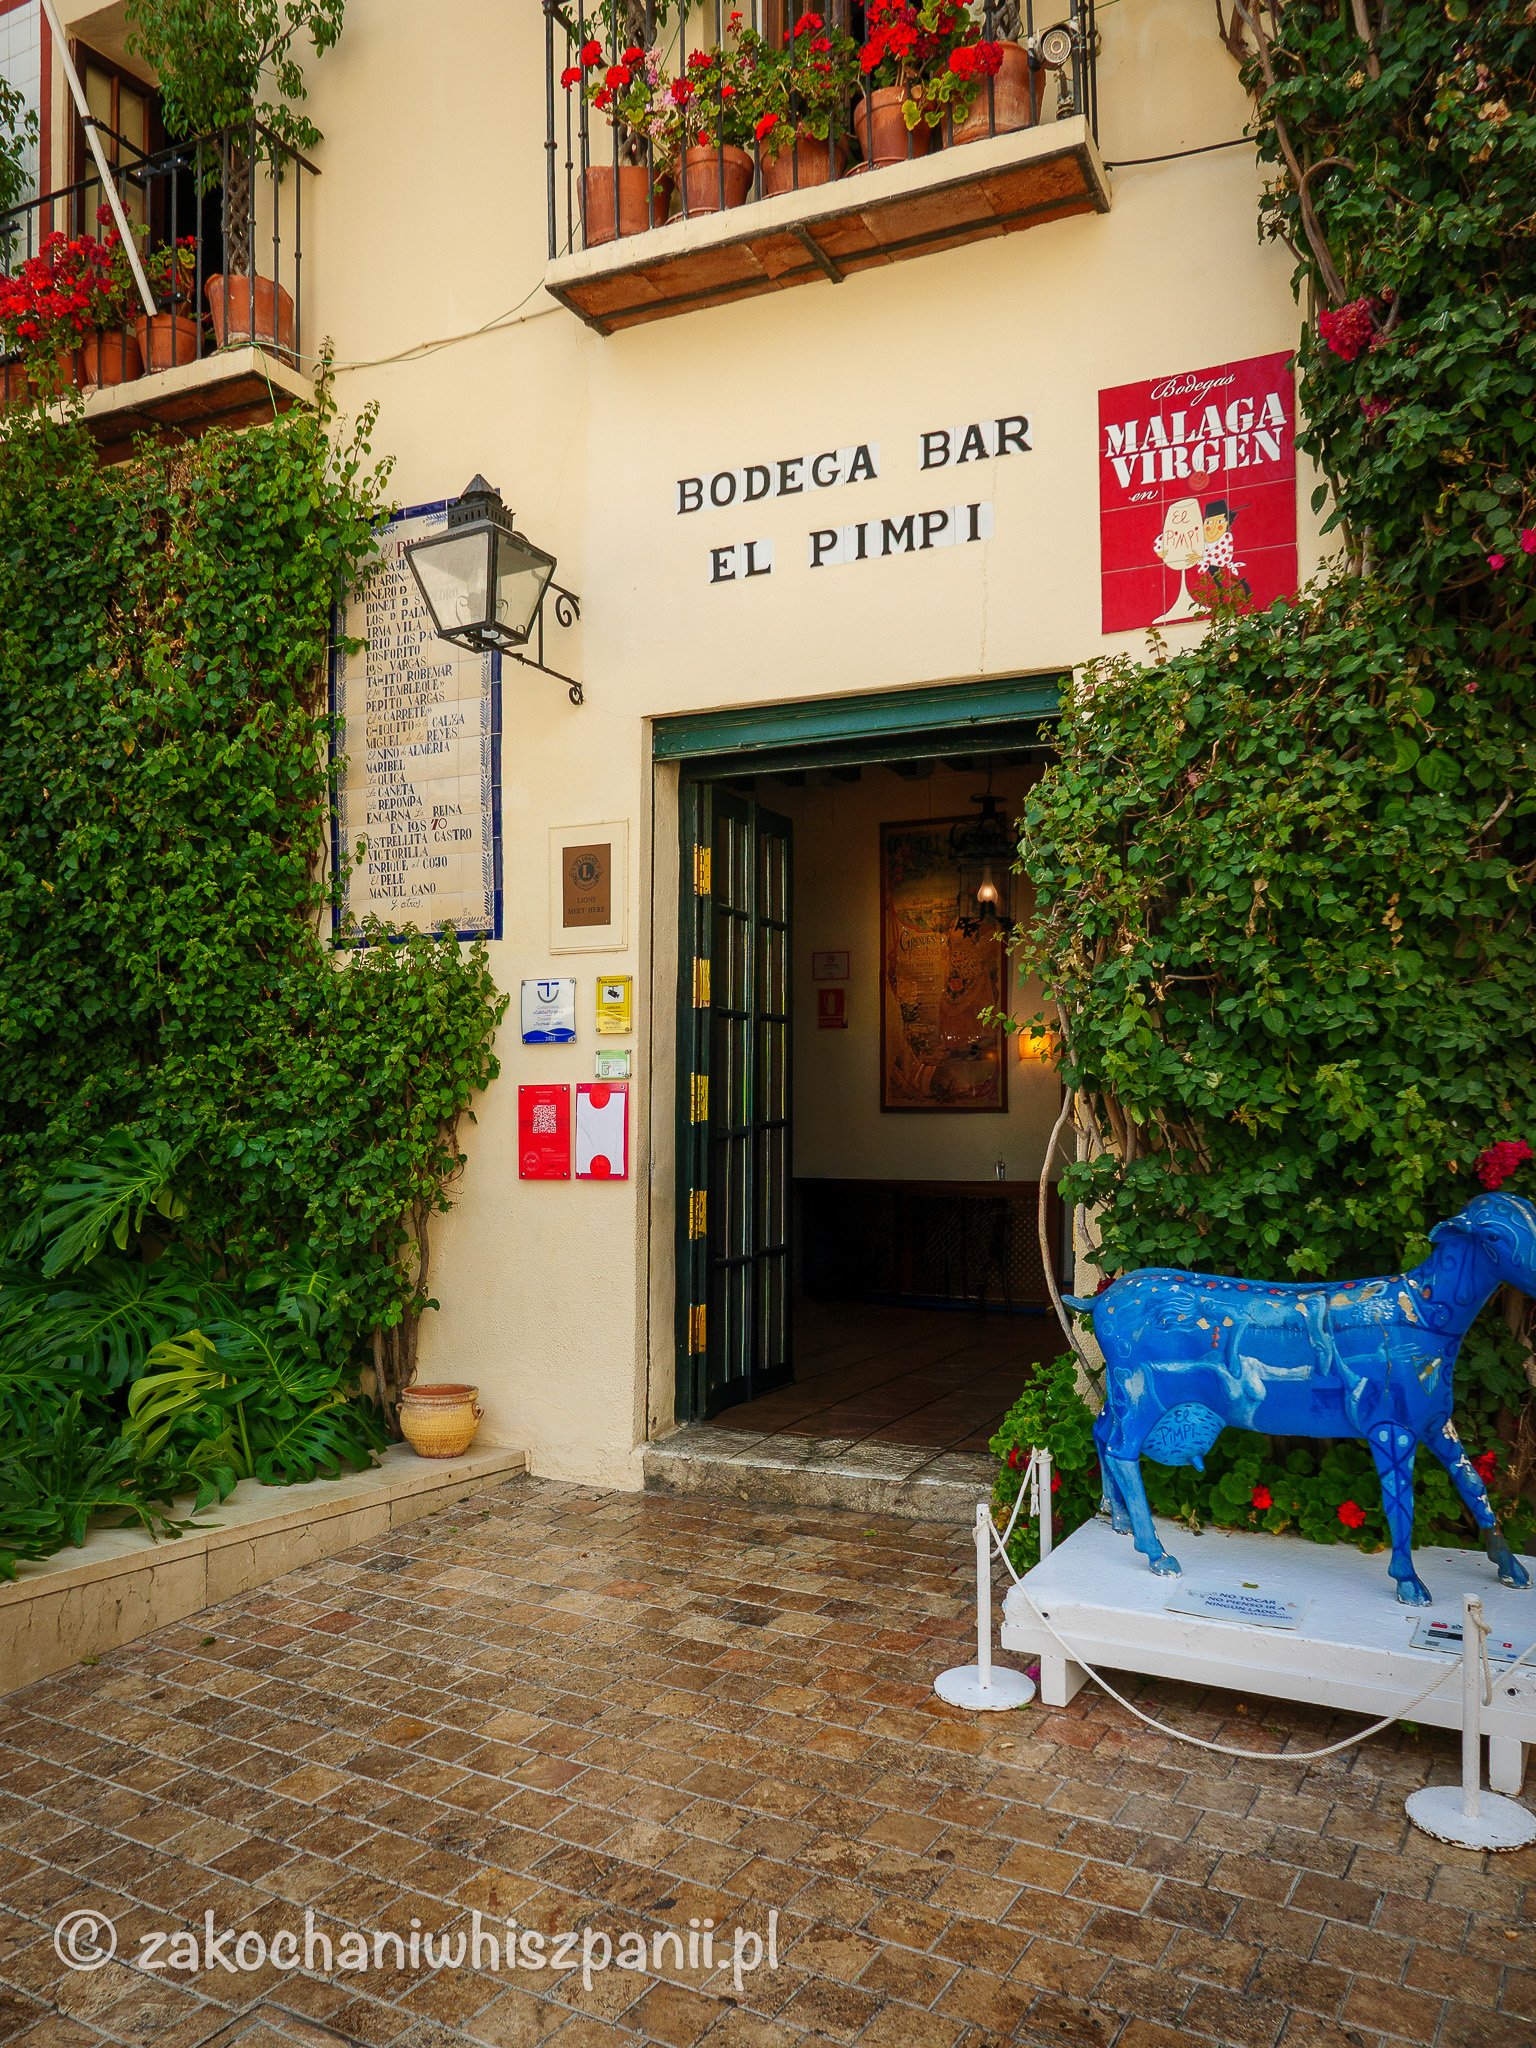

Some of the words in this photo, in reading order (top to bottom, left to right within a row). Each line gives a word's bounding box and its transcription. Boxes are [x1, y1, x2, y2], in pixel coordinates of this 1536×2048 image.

[1151, 374, 1235, 406] Bodegas
[1104, 392, 1287, 458] MALAGA
[677, 445, 877, 515] BODEGA
[920, 415, 1032, 471] BAR
[1111, 427, 1283, 488] VIRGEN
[1128, 490, 1158, 502] en
[1172, 510, 1190, 524] El
[710, 541, 771, 583] EL
[809, 503, 981, 568] PIMPI
[367, 599, 396, 614] BONET
[367, 614, 384, 627] LOS
[401, 606, 429, 620] PALM
[367, 625, 391, 639] IRMA
[396, 620, 422, 633] VILA
[396, 633, 416, 647] LOS
[367, 645, 420, 664] FOSFORITO
[390, 655, 427, 671] VARGAS
[407, 664, 453, 682] ROBEMAR
[366, 698, 402, 713] PEPITO
[408, 691, 445, 707] VARGAS
[432, 713, 465, 728] CALZA
[366, 735, 402, 749] MIGUEL
[427, 727, 458, 742] REYES
[366, 760, 405, 774] MARIBEL
[378, 772, 406, 786] QUICA
[378, 796, 422, 811] REPOMPA
[367, 809, 411, 824] ENCARNA
[433, 804, 463, 818] REINA
[390, 822, 404, 835] EN
[430, 818, 448, 831] 70
[367, 833, 429, 850] ESTRELLITA
[434, 828, 472, 843] CASTRO
[368, 845, 429, 861] VICTORILLA
[369, 860, 409, 875] ENRIQUE
[422, 856, 448, 870] COJO
[381, 873, 405, 886] PELE
[369, 885, 407, 899] MANUEL
[411, 883, 436, 896] CANO
[568, 907, 587, 916] MEET
[1226, 1599, 1264, 1610] PIENSO
[1239, 1596, 1277, 1606] TOCAR
